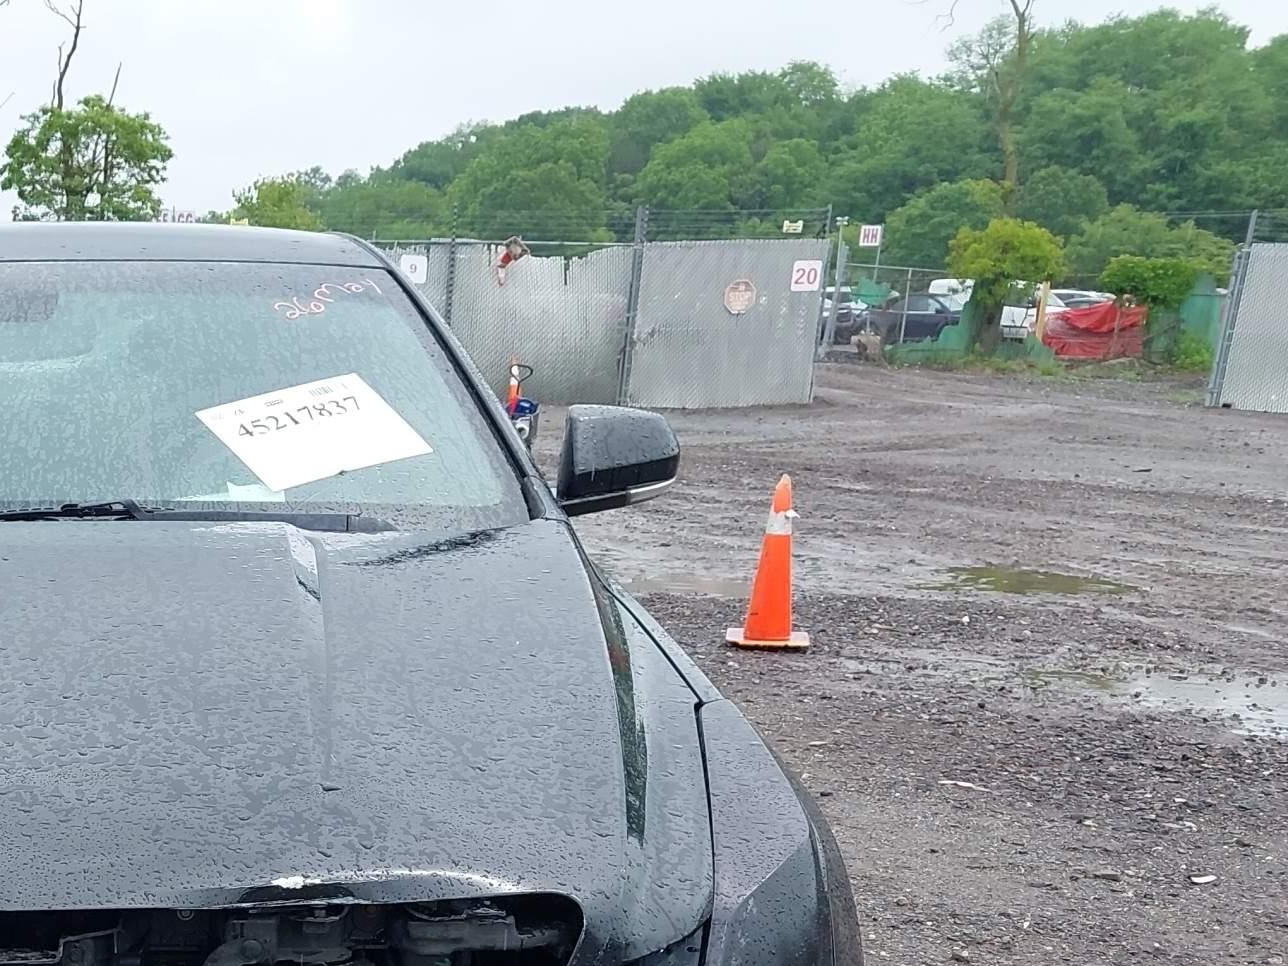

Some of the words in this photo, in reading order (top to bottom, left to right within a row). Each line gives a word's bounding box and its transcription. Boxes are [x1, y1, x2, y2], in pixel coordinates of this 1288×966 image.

[863, 228, 879, 244] HH
[409, 264, 416, 273] 9
[794, 268, 818, 285] 20
[238, 396, 360, 437] 45217837
